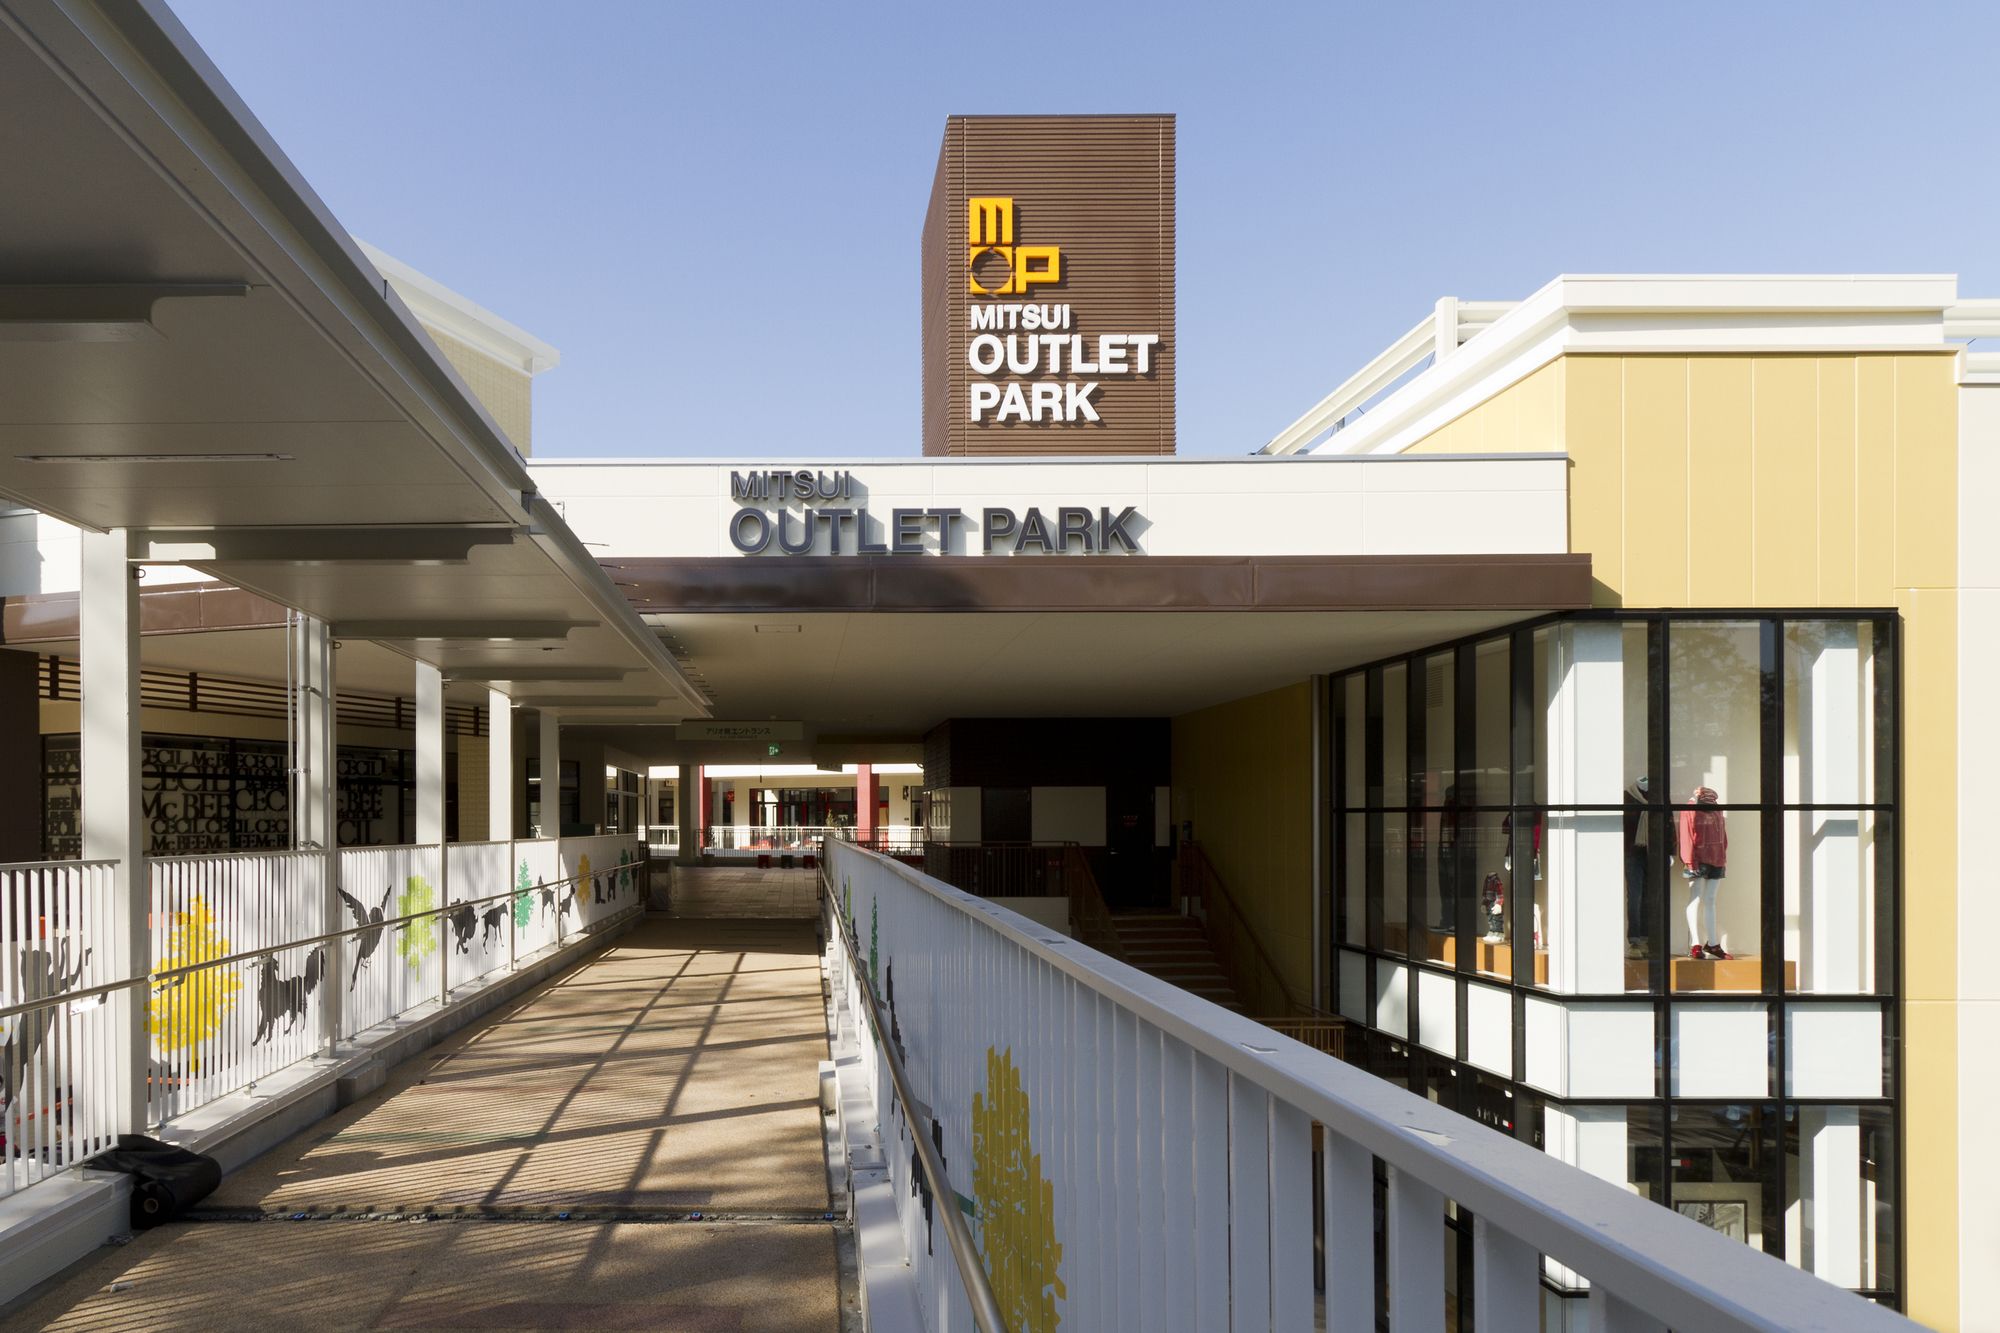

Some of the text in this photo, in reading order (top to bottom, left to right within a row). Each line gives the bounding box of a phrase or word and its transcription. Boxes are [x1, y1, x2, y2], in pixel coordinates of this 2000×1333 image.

[970, 304, 1070, 330] MITSUI
[968, 334, 1159, 374] OUTLET
[970, 382, 1100, 422] PARK
[730, 470, 851, 500] MITSUI
[729, 506, 1138, 555] OUTLET PARK
